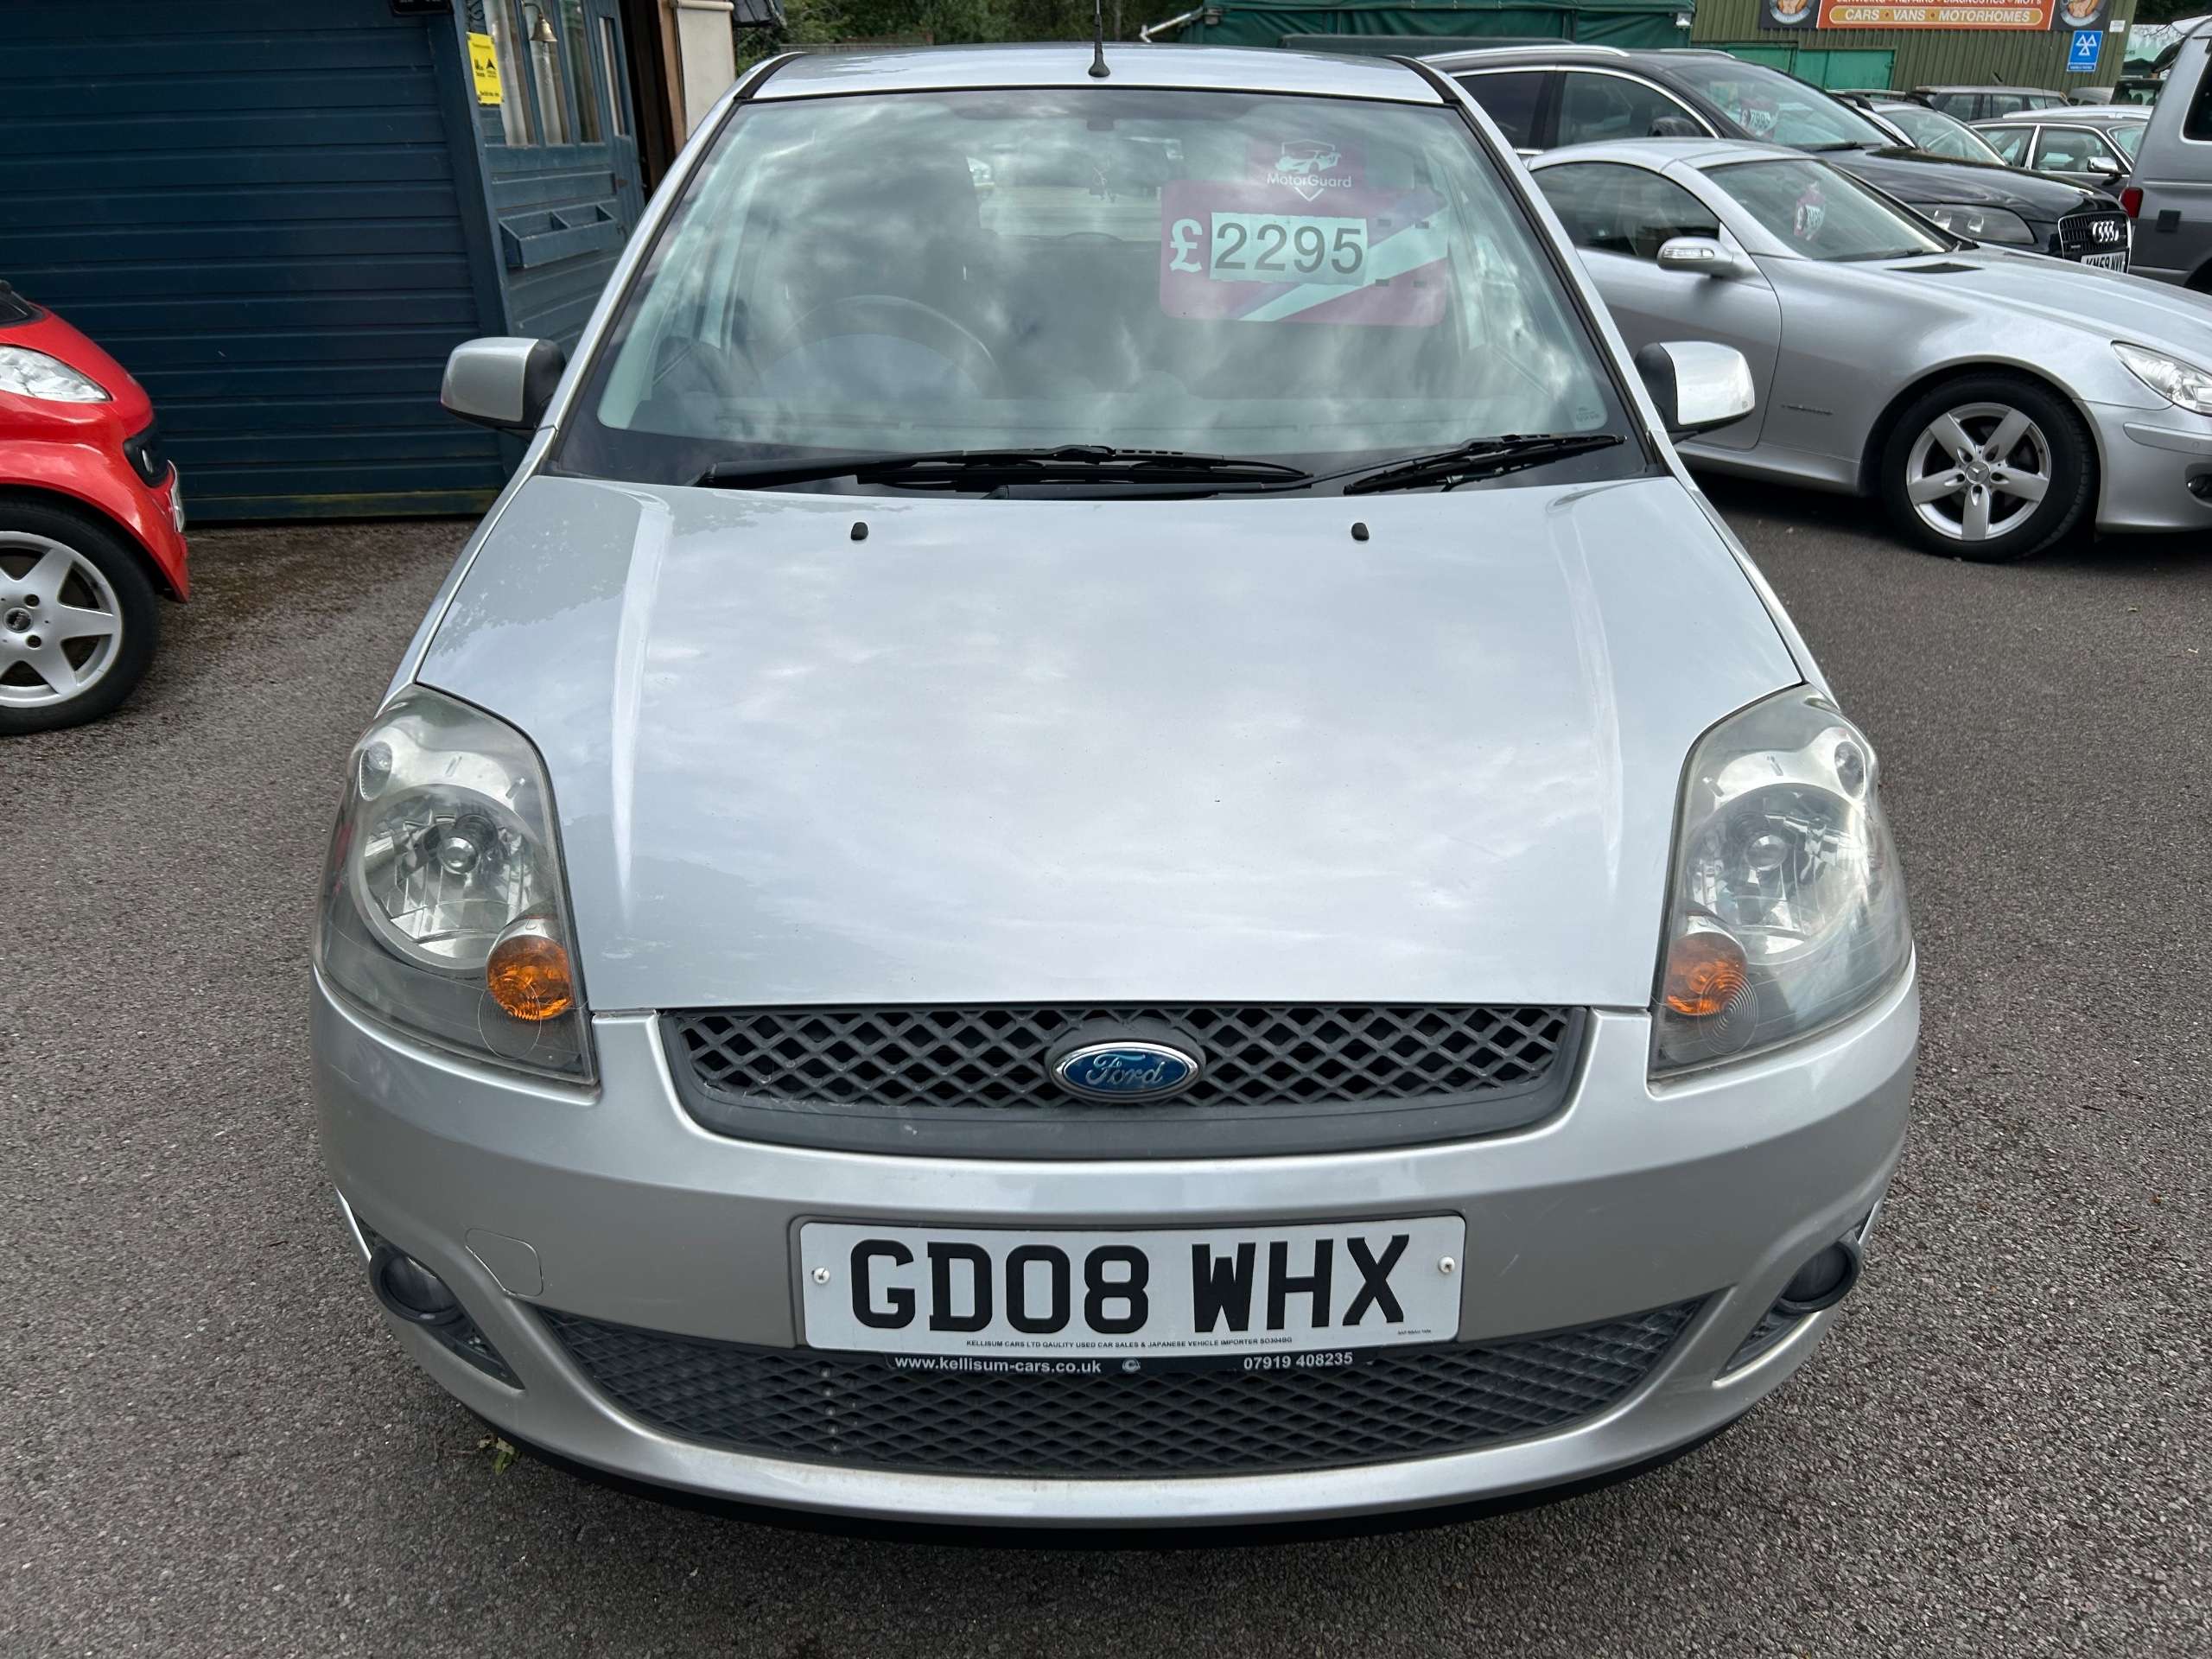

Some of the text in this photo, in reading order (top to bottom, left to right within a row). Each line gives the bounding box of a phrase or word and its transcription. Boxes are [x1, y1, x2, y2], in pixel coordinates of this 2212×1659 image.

[1845, 9, 2031, 22] CARS VANS MOTORHOMES
[1267, 172, 1352, 188] MotorGuard
[1085, 1052, 1166, 1086] Ford
[849, 1233, 1411, 1335] GD08 WHX
[894, 1356, 1102, 1374] www.kellisum-cars.co.uk
[1243, 1351, 1353, 1371] 07919 408235
